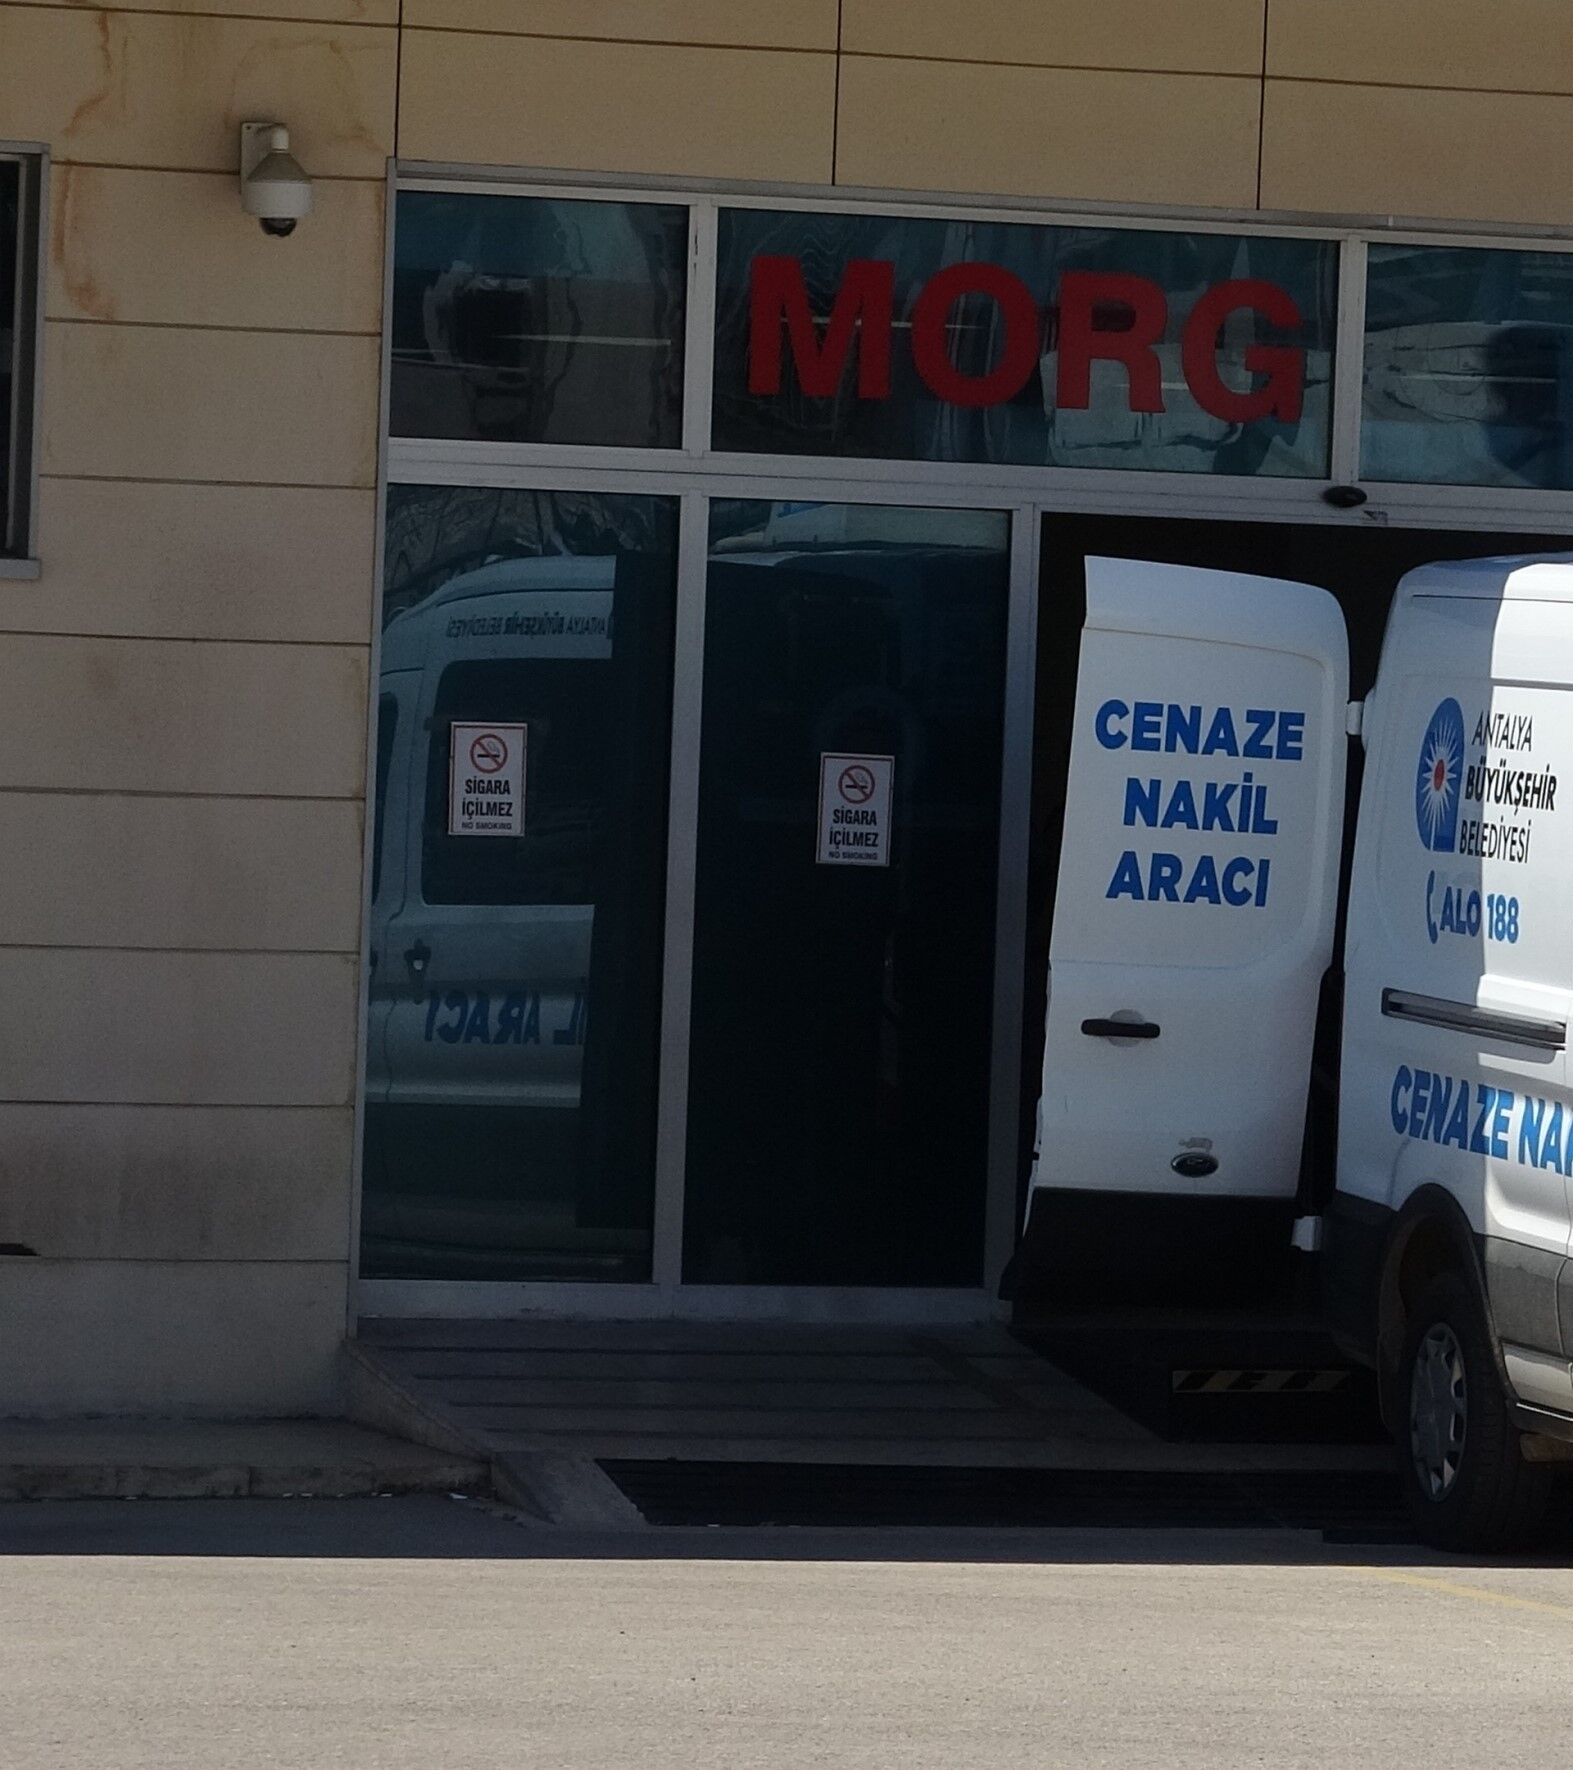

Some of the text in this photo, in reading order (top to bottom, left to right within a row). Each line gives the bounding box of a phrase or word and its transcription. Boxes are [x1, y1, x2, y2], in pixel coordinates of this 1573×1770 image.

[747, 256, 1305, 425] MORG
[1095, 699, 1305, 761] CENAZE
[1472, 710, 1533, 752] ANTALYA
[462, 797, 513, 820] İÇİLMEZ
[464, 776, 511, 795] SİGARA
[1123, 772, 1278, 835] NAKİL
[1465, 756, 1557, 816] BÜYÜKŞEHİR
[829, 826, 879, 849] İÇİLMEZ
[832, 805, 877, 826] SİGARA
[1459, 816, 1532, 864] BELEDİYESİ
[1105, 851, 1270, 907] ARACI
[1440, 886, 1519, 943] ALO 188
[1391, 1064, 1514, 1160] CENAZE
